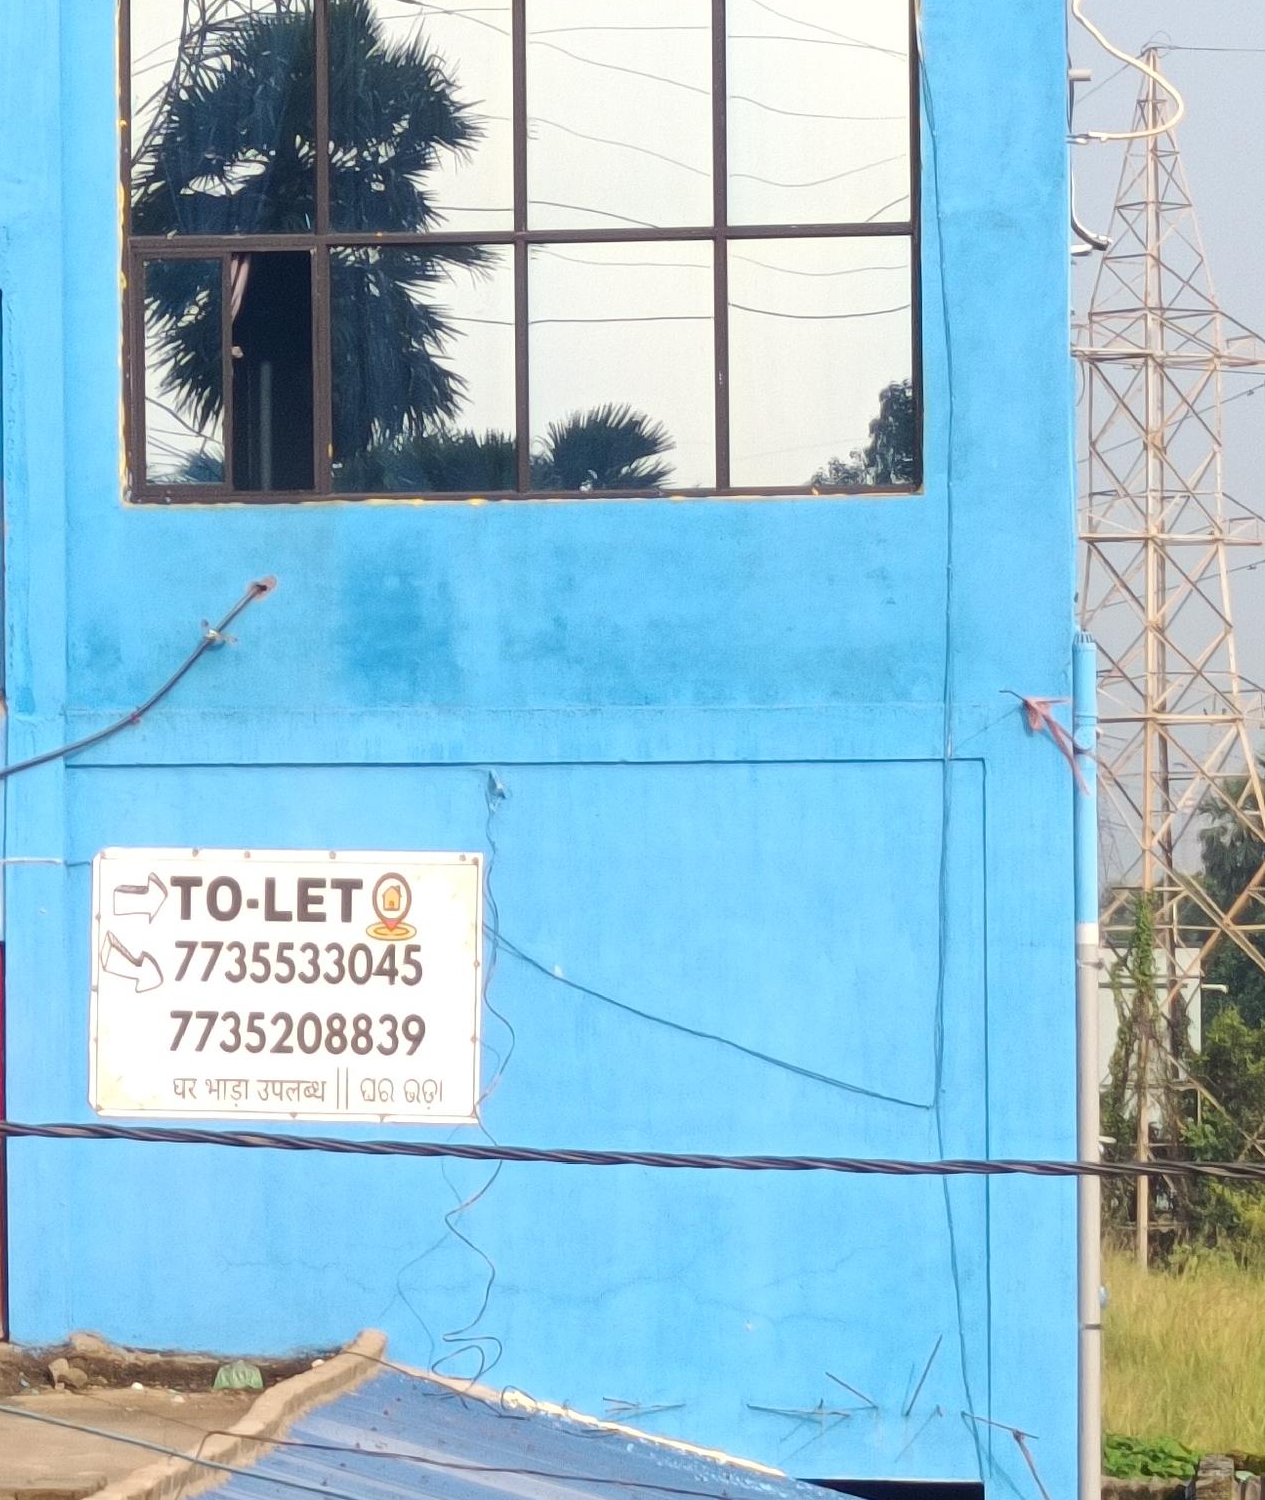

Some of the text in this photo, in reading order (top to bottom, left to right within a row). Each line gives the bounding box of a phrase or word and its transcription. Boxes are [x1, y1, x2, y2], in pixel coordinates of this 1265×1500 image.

[170, 875, 364, 924] TO-LET
[174, 940, 424, 986] 7735533045
[168, 1010, 427, 1056] 7735208839
[173, 1078, 197, 1100] घर
[256, 1079, 327, 1103] उपलब्ध
